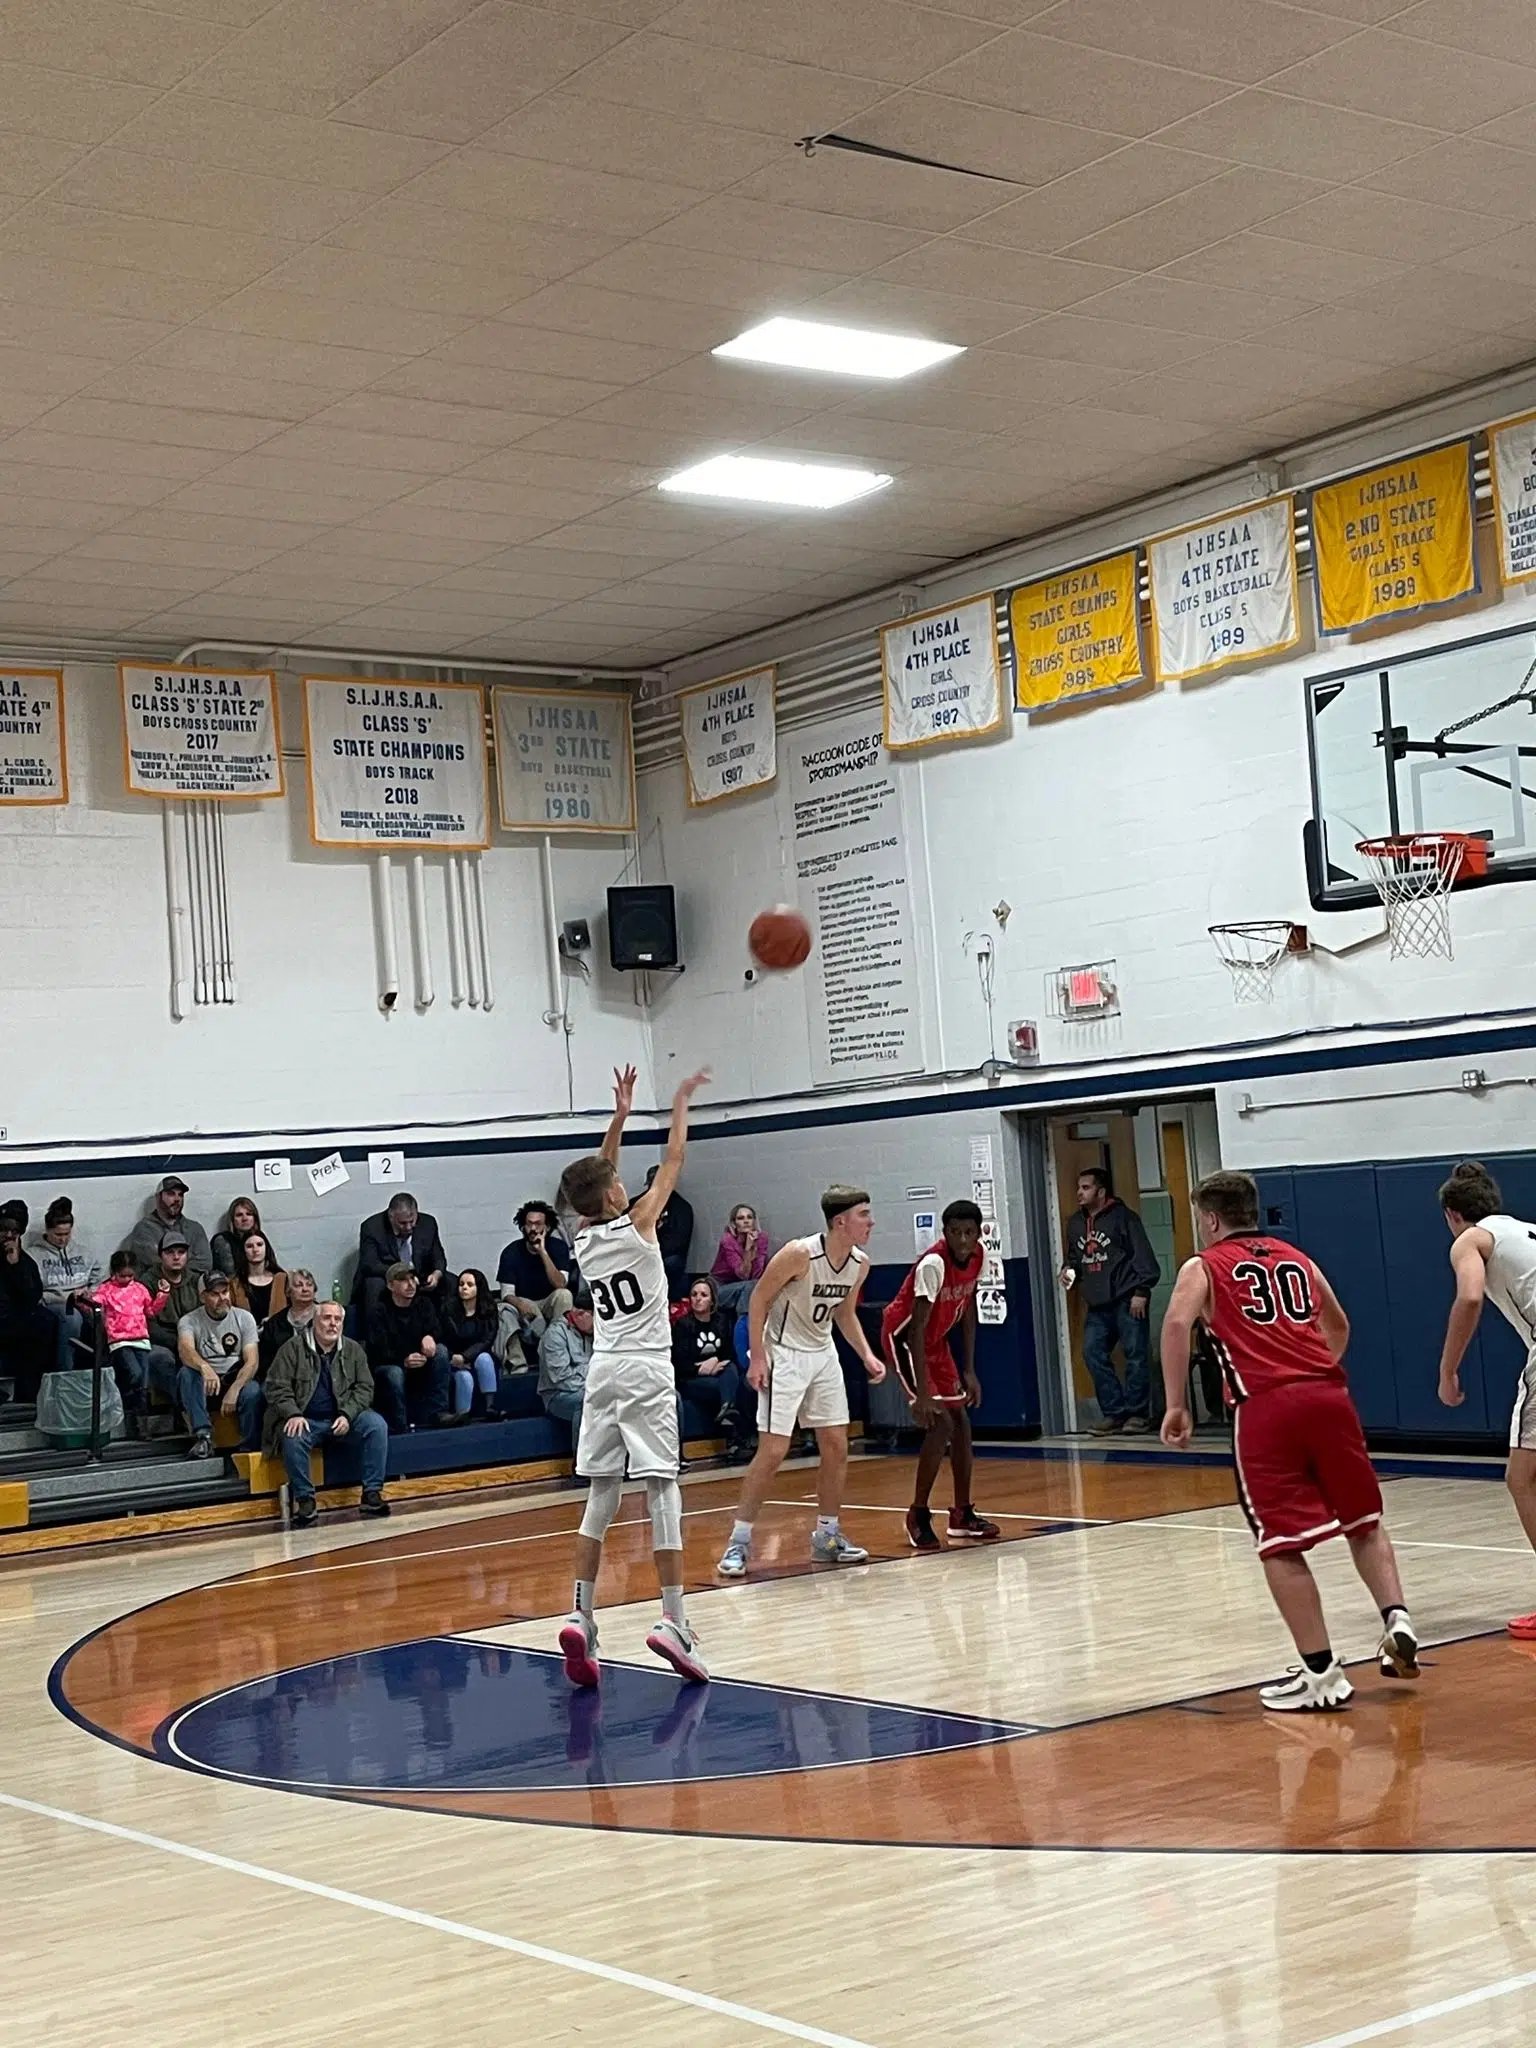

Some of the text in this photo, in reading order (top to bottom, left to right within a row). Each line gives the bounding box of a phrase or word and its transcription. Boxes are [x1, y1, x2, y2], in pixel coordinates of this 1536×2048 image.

[1360, 472, 1418, 505] IJHSAA
[1346, 498, 1436, 541] 2ND STATE
[1187, 523, 1251, 560] IJHSAA
[1351, 526, 1435, 562] GIRLS TRACK
[1182, 548, 1259, 587] 4TH STATE
[1369, 552, 1420, 577] CLASS S
[1173, 572, 1272, 615] BOYS BASKETBALL
[1374, 577, 1415, 604] 1989
[1029, 590, 1117, 631] STATE CHAMPS
[1241, 602, 1247, 616] S
[912, 617, 960, 646] IJHSAA
[1057, 621, 1092, 645] GIRLS
[905, 638, 971, 670] 4TH PLACE
[1069, 635, 1123, 664] COUNTRY
[931, 668, 953, 685] GIRLS
[132, 694, 179, 712] CLASS
[204, 699, 246, 715] STATE
[347, 688, 443, 709] S.I.J.H.S.A.A.
[708, 685, 747, 711] IJHSAA
[911, 685, 970, 709] CROSS COUNTRY
[143, 715, 257, 732] BOYS CROSS COUNTRY
[363, 715, 408, 732] CLASS
[528, 706, 598, 731] IJHSAA
[702, 703, 755, 732] 4TH PLACE
[932, 708, 959, 728] 1987
[187, 734, 218, 749] 2017
[333, 739, 464, 761] STATE CHAMPIONS
[556, 735, 611, 760] STATE
[801, 733, 884, 767] RACCOON CODE OF
[366, 765, 434, 780] BOYS TRACK
[554, 763, 611, 778] BASKETBALL
[809, 751, 878, 784] SPORTSMANSHIP
[385, 787, 418, 804] 2018
[545, 782, 577, 793] CLASS
[546, 798, 590, 819] 1980
[264, 1163, 281, 1176] EC
[311, 1158, 341, 1180] PreK
[381, 1158, 392, 1174] 2
[590, 1270, 645, 1321] 30
[1232, 1261, 1313, 1325] 30
